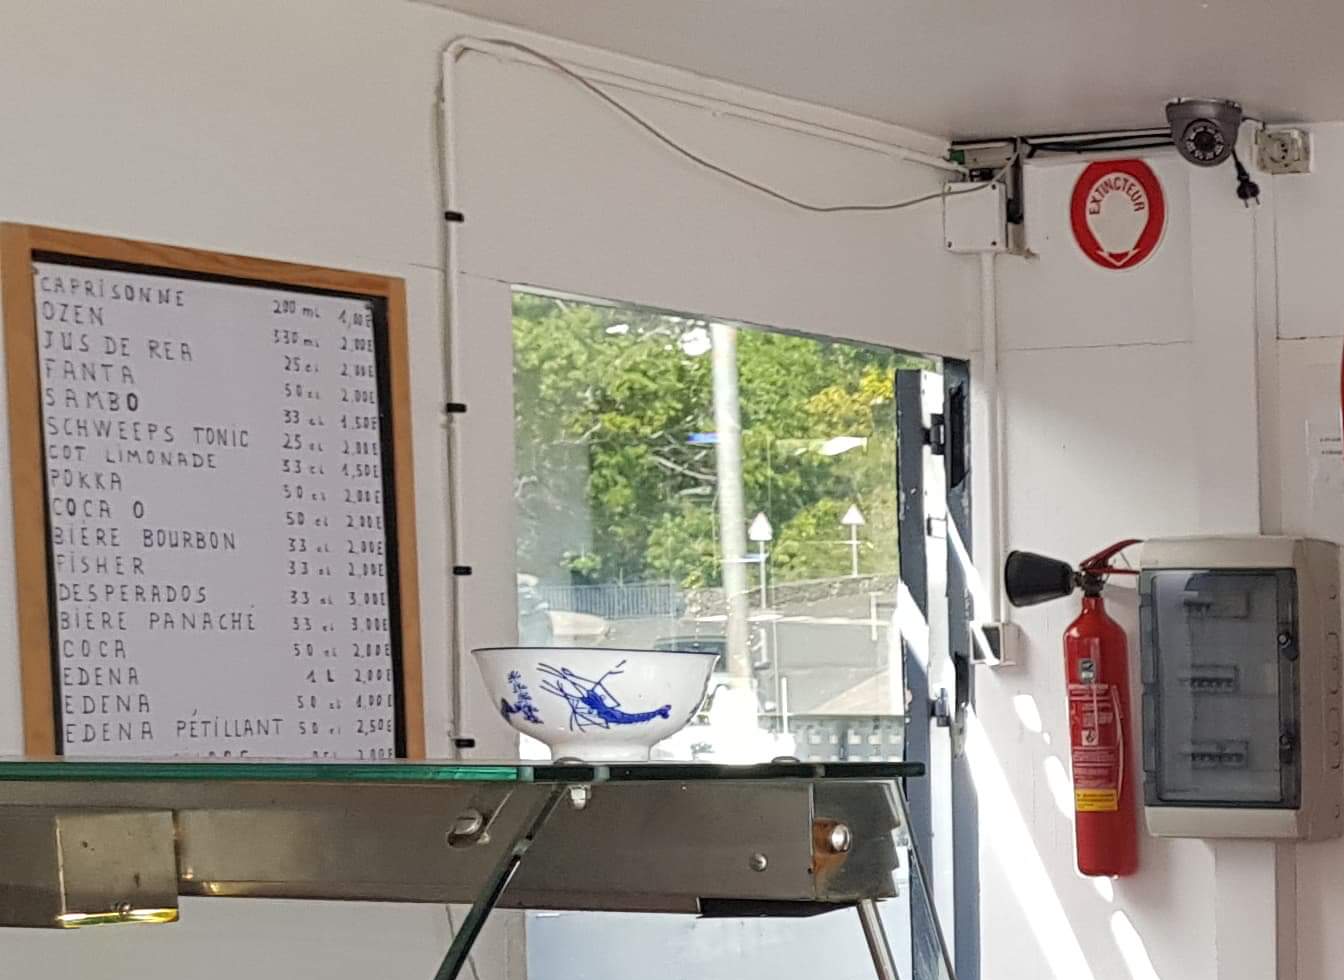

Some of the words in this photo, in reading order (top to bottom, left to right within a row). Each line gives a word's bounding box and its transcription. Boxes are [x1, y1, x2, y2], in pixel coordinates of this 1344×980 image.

[1088, 176, 1145, 216] EXTINCTEUR
[40, 276, 185, 307] CAPRISONNE
[42, 300, 105, 326] OZEN
[44, 329, 90, 353] JUS
[103, 335, 131, 358] DE
[148, 338, 193, 361] REA
[44, 358, 135, 385] FANTA
[45, 387, 139, 413] SAMBO
[47, 415, 175, 443] SCHWEEPS
[192, 425, 249, 448] TONIC
[48, 444, 87, 462] COT
[106, 445, 217, 469] LIMONADE
[50, 468, 123, 491] POKKA
[53, 497, 112, 519] COCA
[142, 528, 236, 550] BOURBON
[56, 551, 145, 576] FISHER
[58, 583, 207, 604] DESPERADOS
[63, 639, 127, 659] COCA
[63, 666, 139, 687] EDENA
[64, 693, 151, 715] EDENA
[66, 721, 154, 744] EDENA
[176, 707, 284, 738] PÉTILLANT
